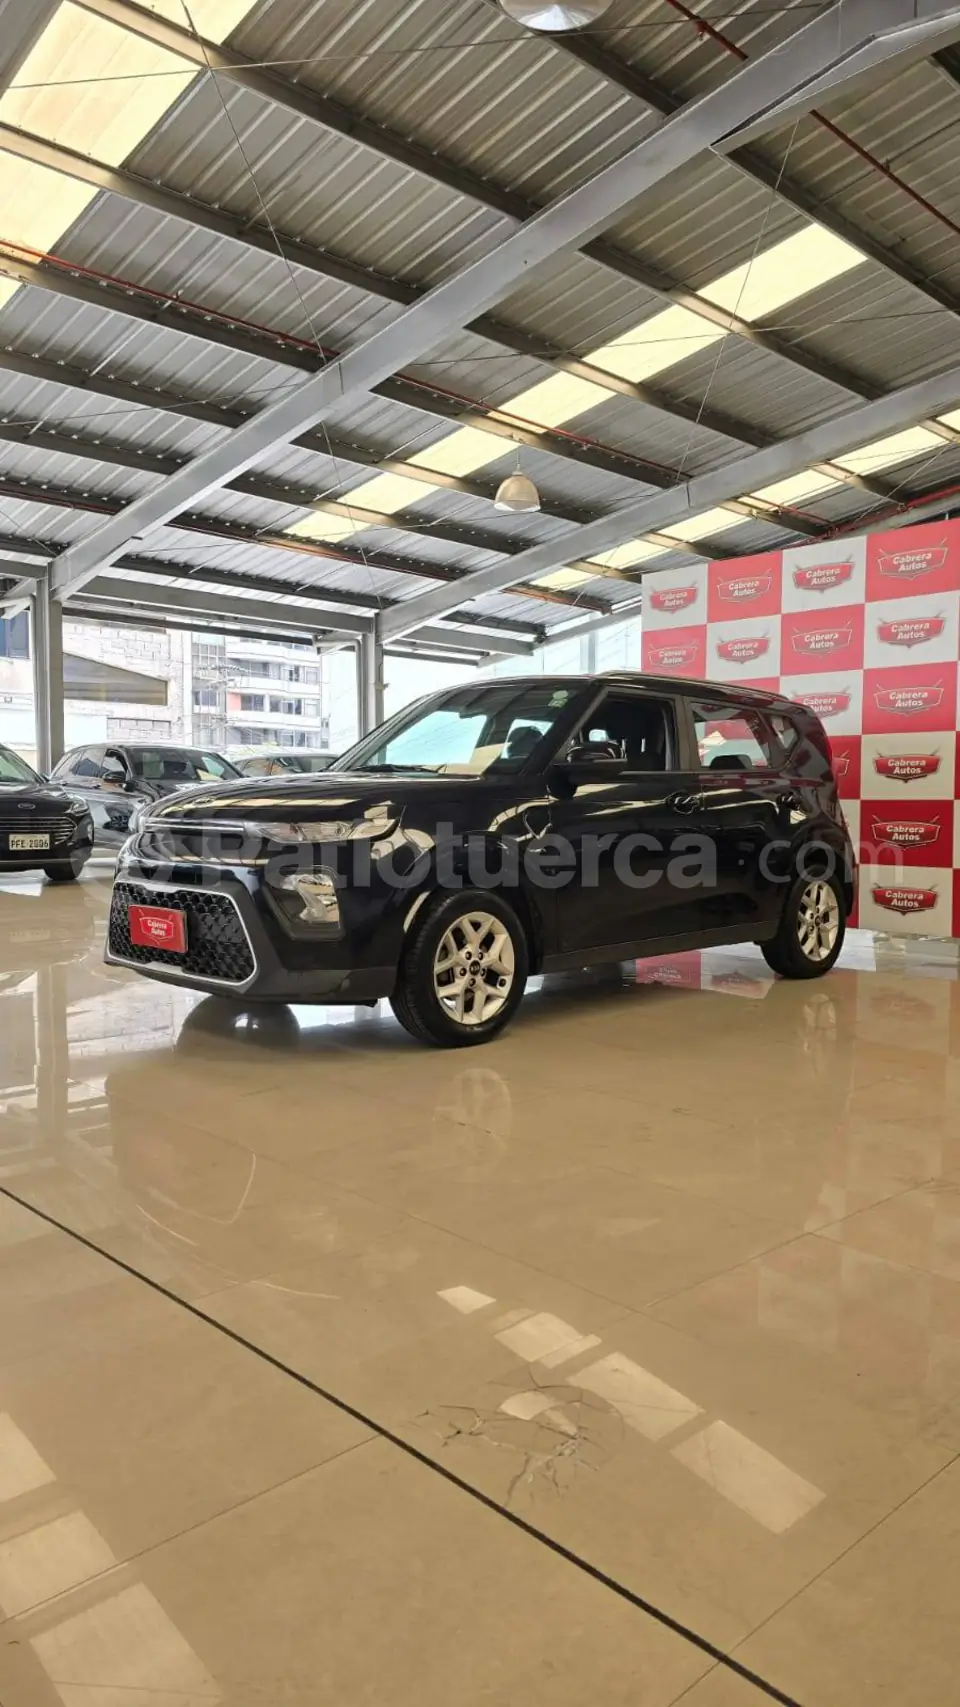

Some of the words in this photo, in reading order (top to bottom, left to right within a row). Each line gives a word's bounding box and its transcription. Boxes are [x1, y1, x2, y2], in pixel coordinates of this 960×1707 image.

[892, 552, 932, 565] Cabrera
[898, 561, 927, 572] Autos
[805, 566, 841, 579] Cabrera
[728, 580, 760, 590] Cabrera
[810, 575, 836, 585] Autos
[733, 588, 756, 597] Autos
[891, 621, 930, 633] Cabrera
[804, 632, 839, 642] Cabrera
[897, 630, 926, 640] Autos
[728, 641, 759, 651] Cabrera
[809, 640, 834, 649] Autos
[732, 649, 755, 657] Autos
[802, 695, 837, 706] Cabrera
[889, 690, 928, 701] Cabrera
[895, 698, 924, 708] Autos
[887, 758, 926, 767] Cabrera
[893, 765, 922, 774] Autos
[886, 825, 925, 833] Cabrera
[892, 833, 920, 841] Autos
[885, 890, 924, 900] Cabrera
[891, 899, 919, 908] Autos
